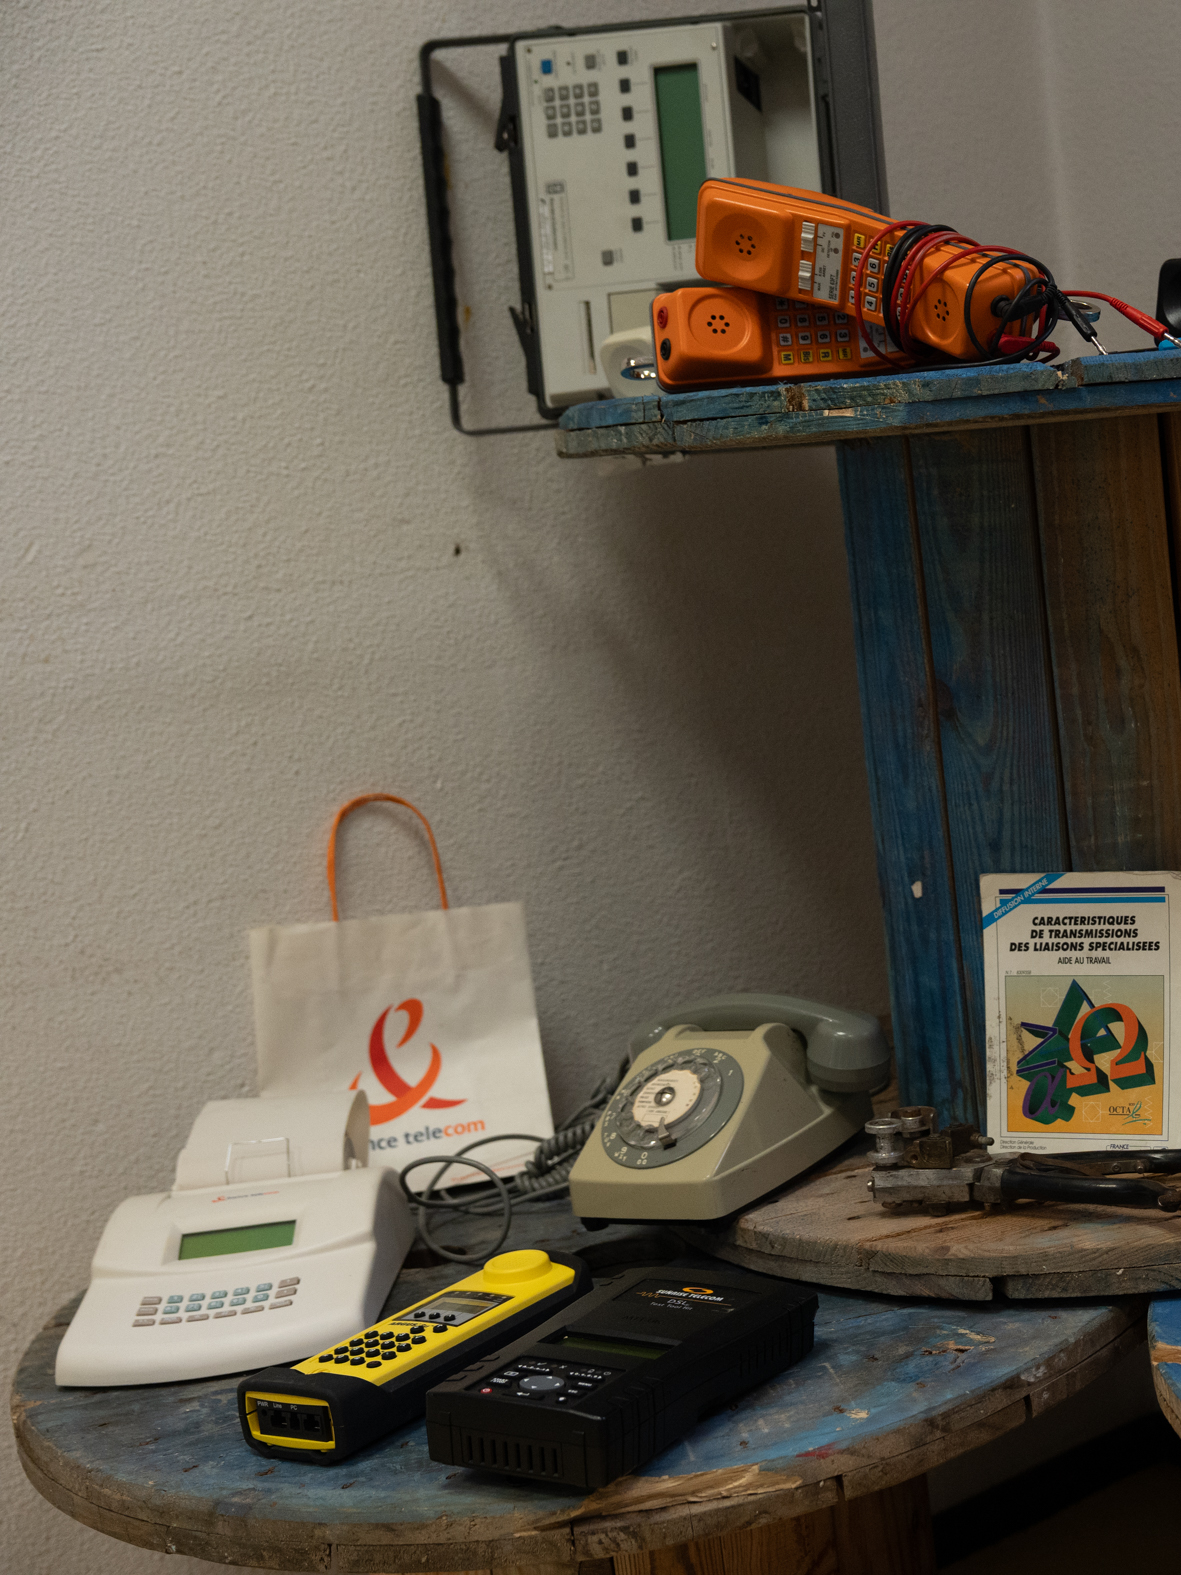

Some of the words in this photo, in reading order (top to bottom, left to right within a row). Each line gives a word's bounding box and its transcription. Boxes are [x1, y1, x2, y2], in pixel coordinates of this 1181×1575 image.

[802, 351, 810, 362] Bis
[993, 894, 1024, 919] DIFFUSION
[1023, 878, 1049, 900] INTERNE
[1032, 915, 1136, 926] CARACTERISTIQUES
[1030, 929, 1044, 939] DE
[1048, 928, 1138, 938] TRANSMISSIONS
[1009, 942, 1030, 952] DES
[1033, 941, 1084, 952] LIAISONS
[1088, 941, 1160, 951] SPECIALISEES
[1057, 956, 1073, 965] AIDE
[1074, 956, 1085, 965] AU
[1086, 956, 1112, 965] TRAVAIL
[403, 1119, 486, 1146] telecom
[655, 1289, 687, 1297] SUNRISE
[687, 1292, 724, 1302] TELECOM
